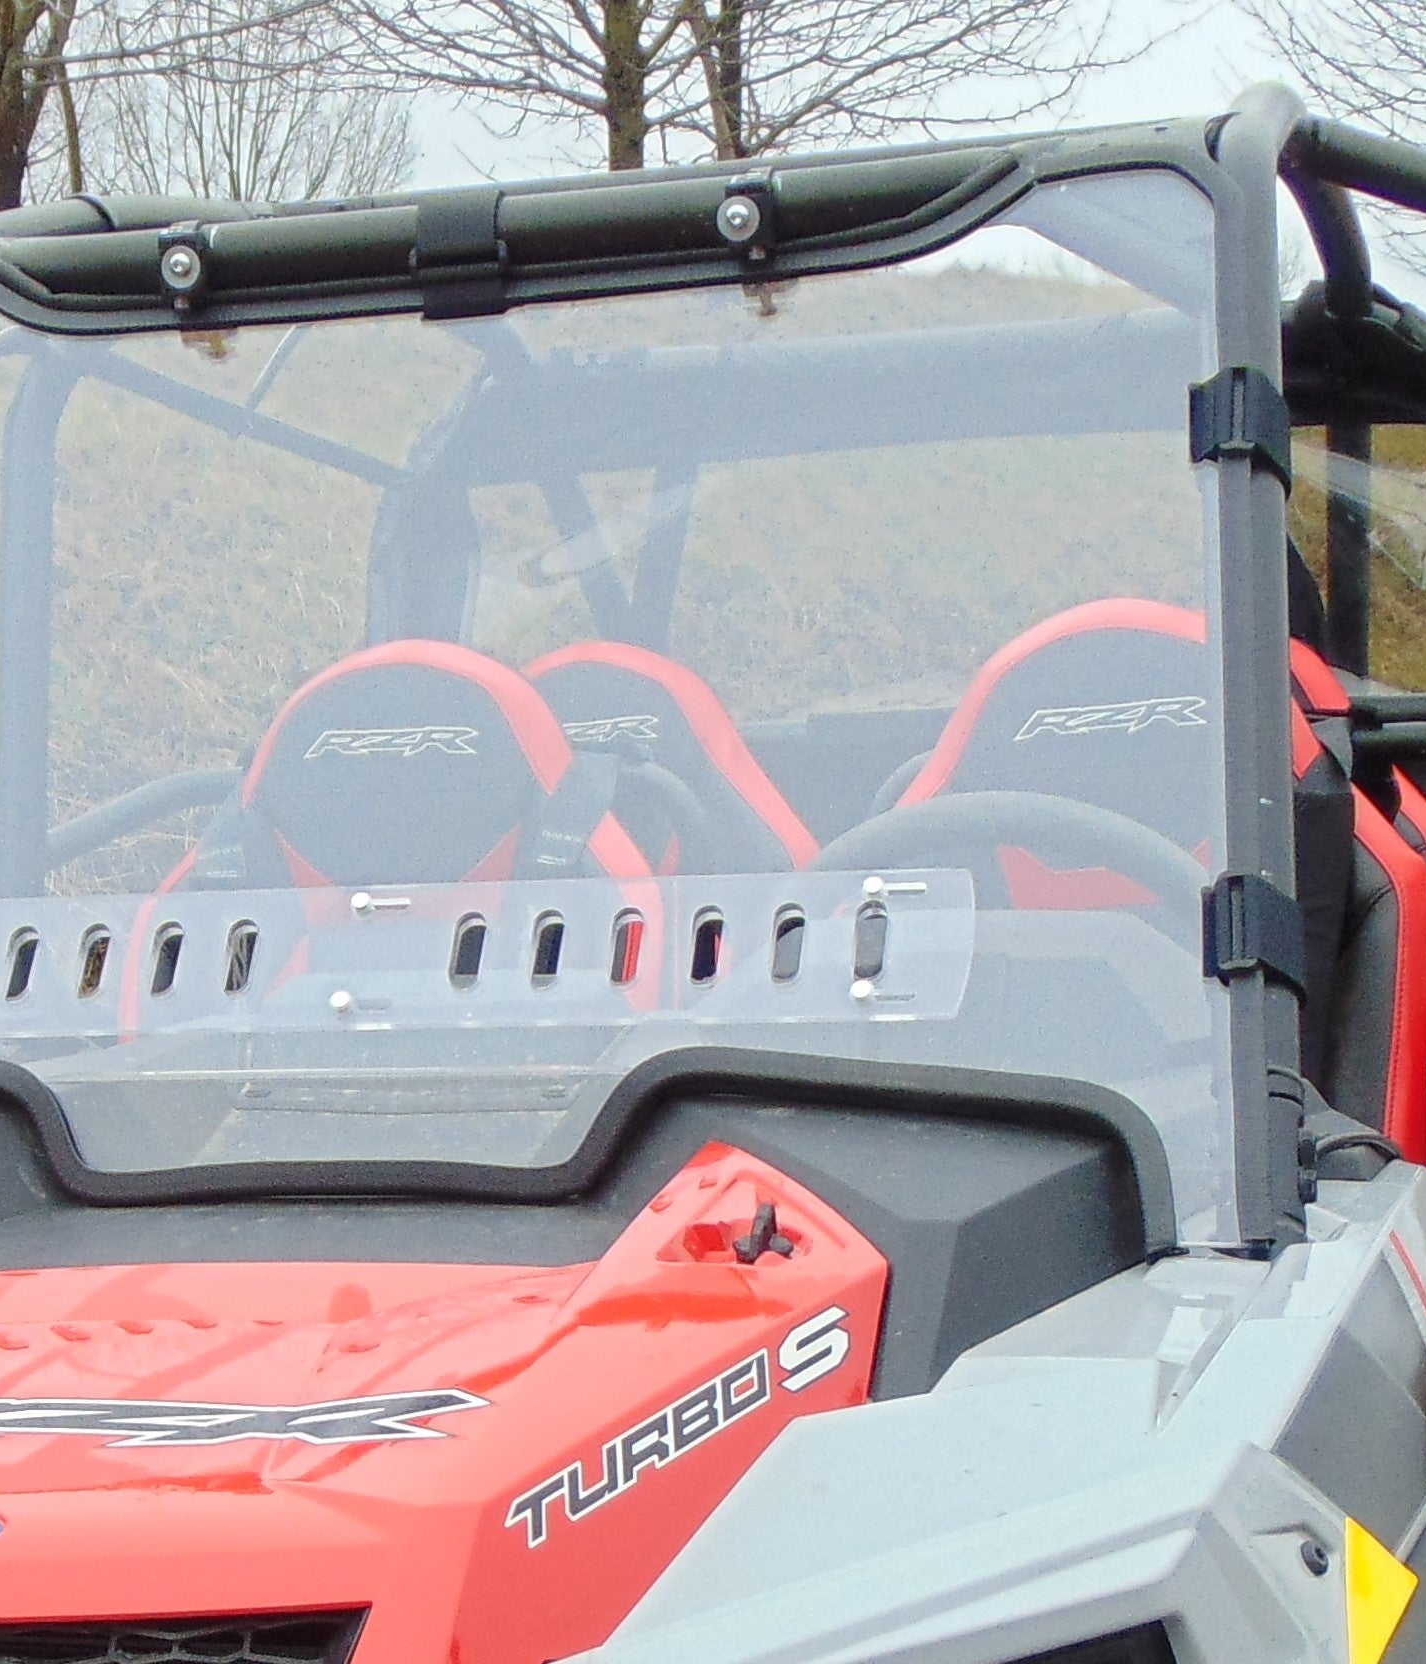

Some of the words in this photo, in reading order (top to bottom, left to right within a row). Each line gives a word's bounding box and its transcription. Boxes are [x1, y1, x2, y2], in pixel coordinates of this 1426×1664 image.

[561, 714, 659, 742] ZR
[1013, 696, 1208, 741] RZR
[303, 726, 479, 759] RZR
[504, 1347, 771, 1549] TURBO
[777, 1304, 850, 1393] S
